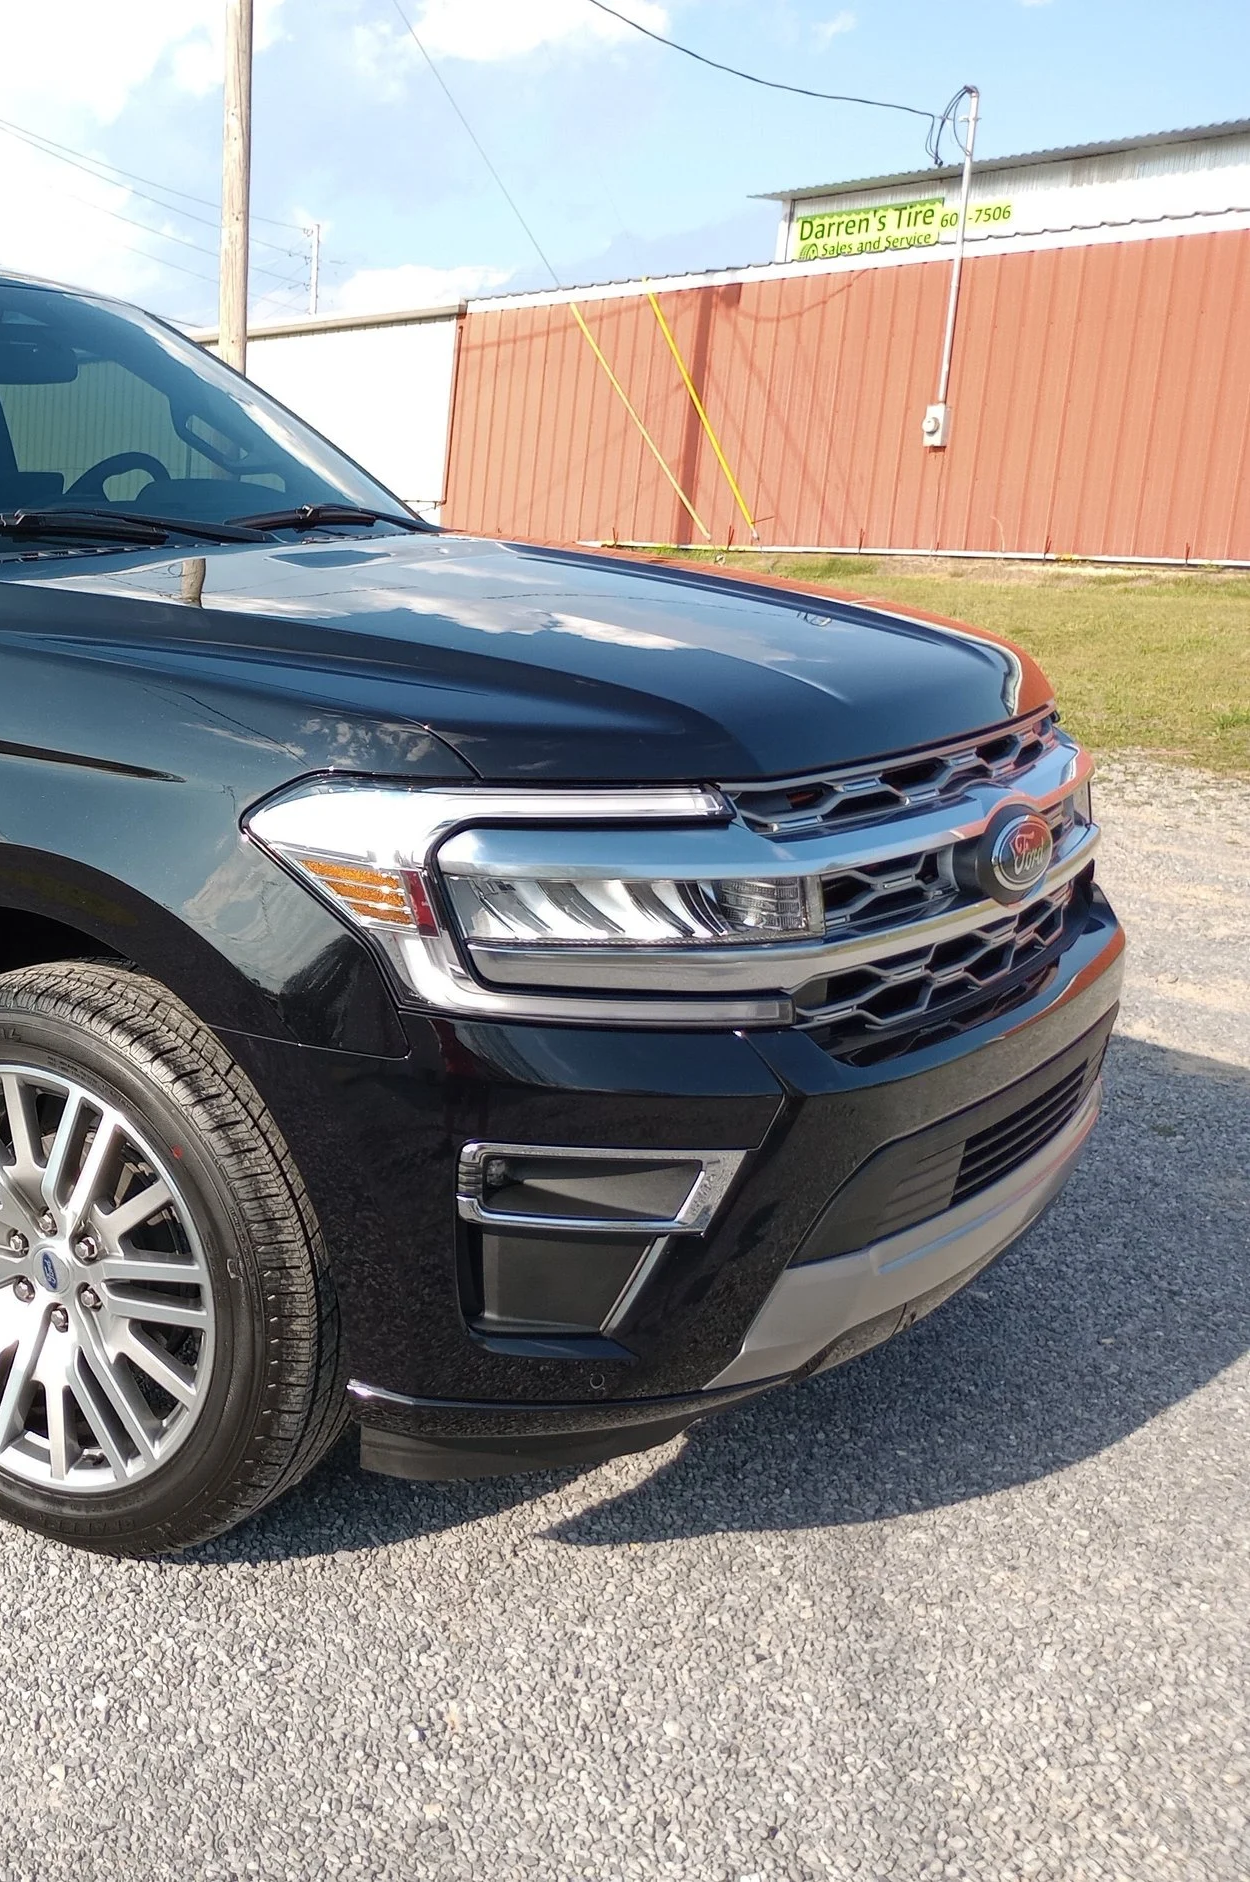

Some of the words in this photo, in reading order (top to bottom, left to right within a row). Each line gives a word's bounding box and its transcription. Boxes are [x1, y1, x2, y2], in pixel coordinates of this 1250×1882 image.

[800, 210, 887, 241] Darren's
[896, 205, 935, 229] Tire
[940, 205, 1012, 228] 60-7506
[821, 241, 853, 257] Sales
[856, 235, 881, 252] and
[885, 232, 932, 250] Service
[1009, 829, 1044, 876] Ford
